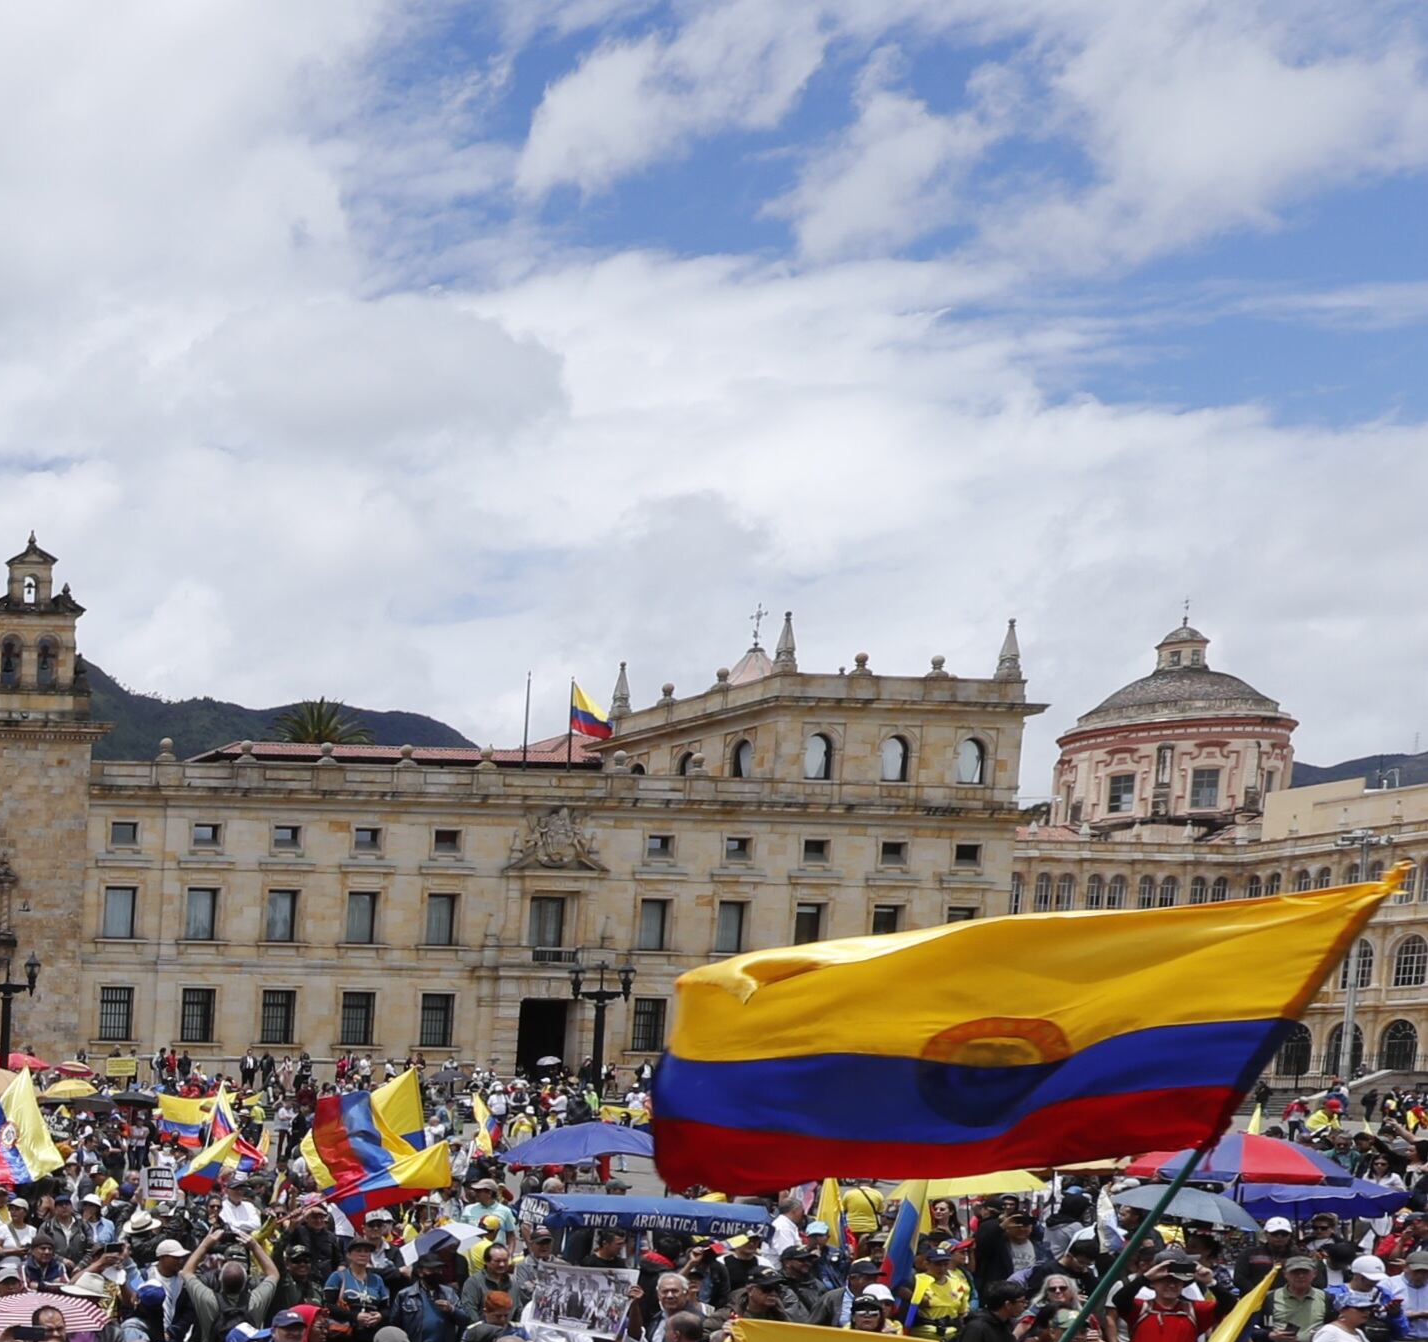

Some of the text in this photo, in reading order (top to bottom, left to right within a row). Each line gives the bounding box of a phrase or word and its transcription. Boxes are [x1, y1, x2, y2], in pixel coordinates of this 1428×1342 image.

[583, 1213, 770, 1239] TINTO AROMATICA CANEZO
